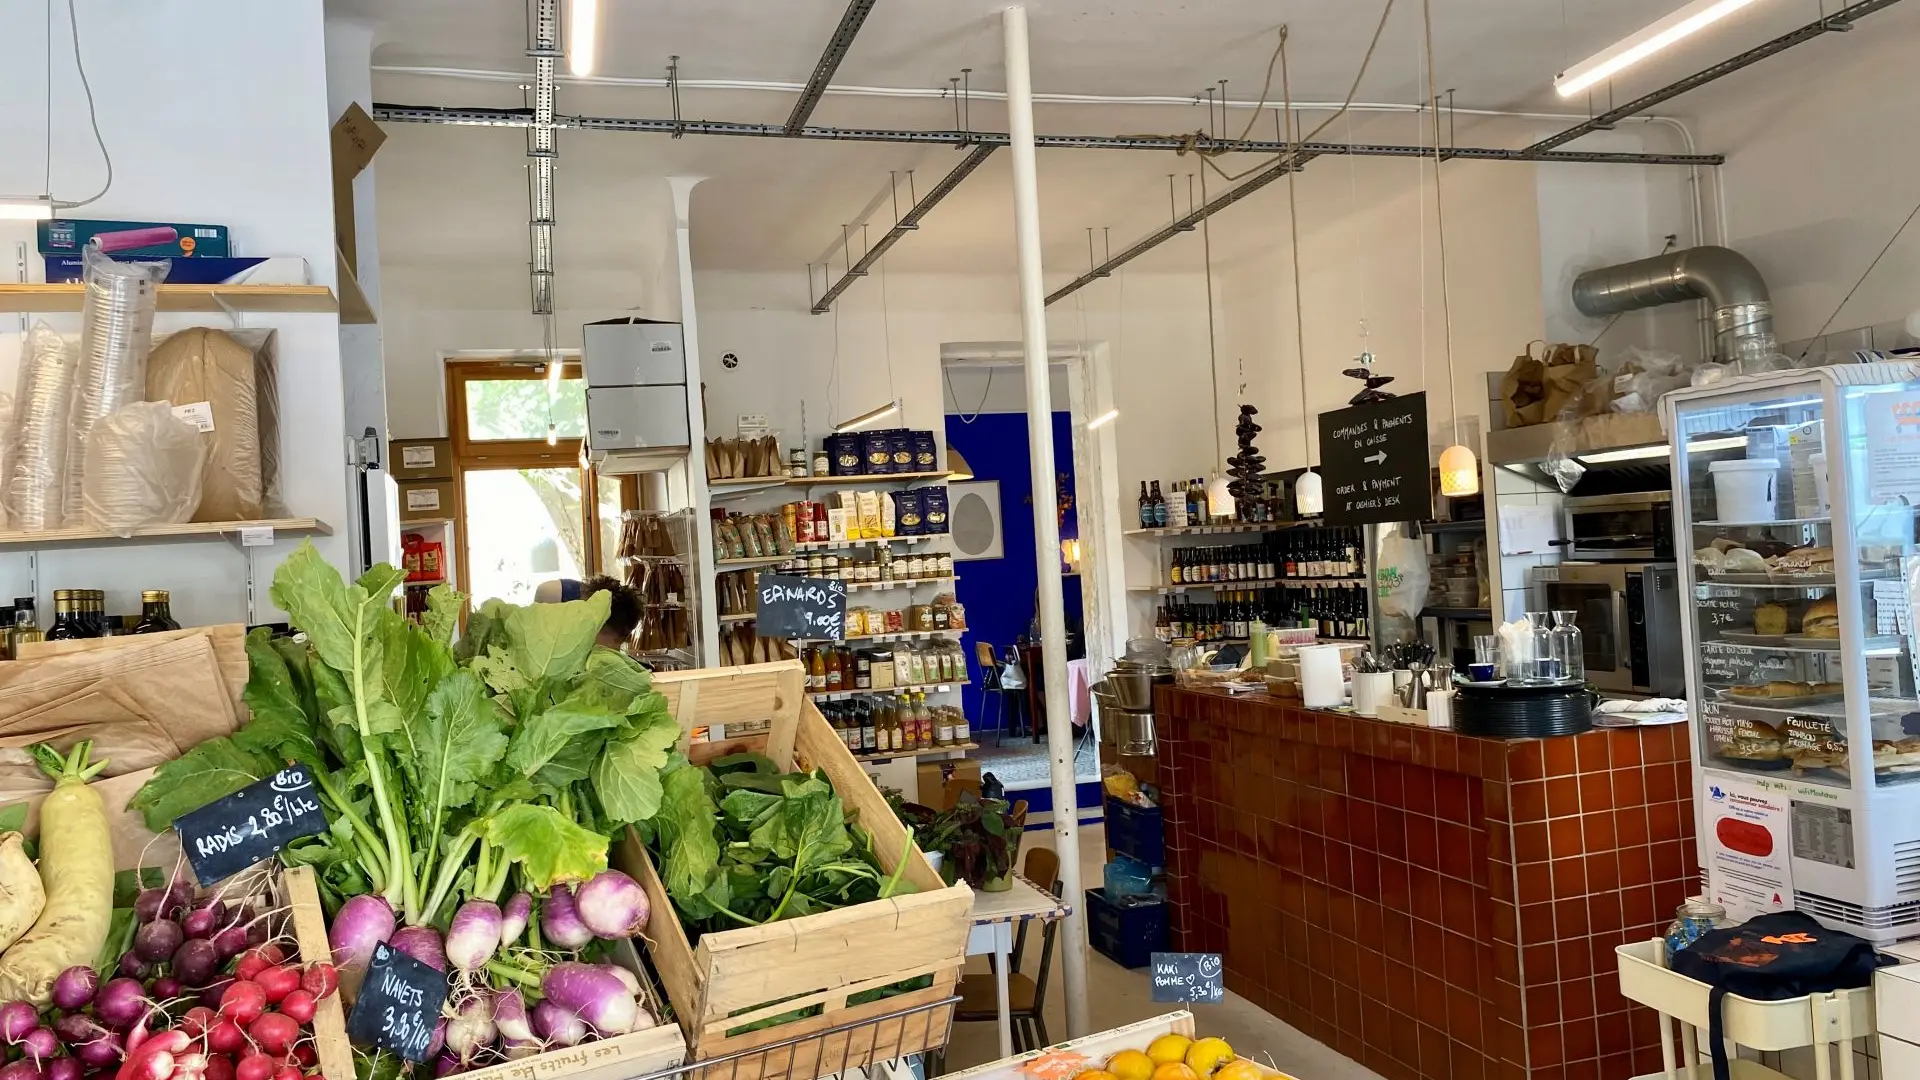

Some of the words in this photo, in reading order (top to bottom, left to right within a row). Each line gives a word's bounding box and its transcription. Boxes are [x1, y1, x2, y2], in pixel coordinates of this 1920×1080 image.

[1333, 422, 1368, 440] COMMANDES
[1354, 440, 1362, 449] EN
[1366, 434, 1388, 446] CAISSE
[1336, 484, 1355, 494] ORDER
[1372, 476, 1402, 491] PAYMENT
[1346, 501, 1353, 511] AT
[1385, 495, 1401, 507] DESK
[1700, 645, 1723, 654] TARTE
[1788, 729, 1816, 741] JAMBON
[1788, 737, 1821, 752] FROMAGE
[195, 824, 244, 858] RADiS
[1157, 962, 1179, 975] KAKi
[1154, 975, 1185, 987] POMME
[380, 974, 424, 1007] NAVETS
[595, 1045, 622, 1058] Les
[540, 1051, 588, 1071] fruits
